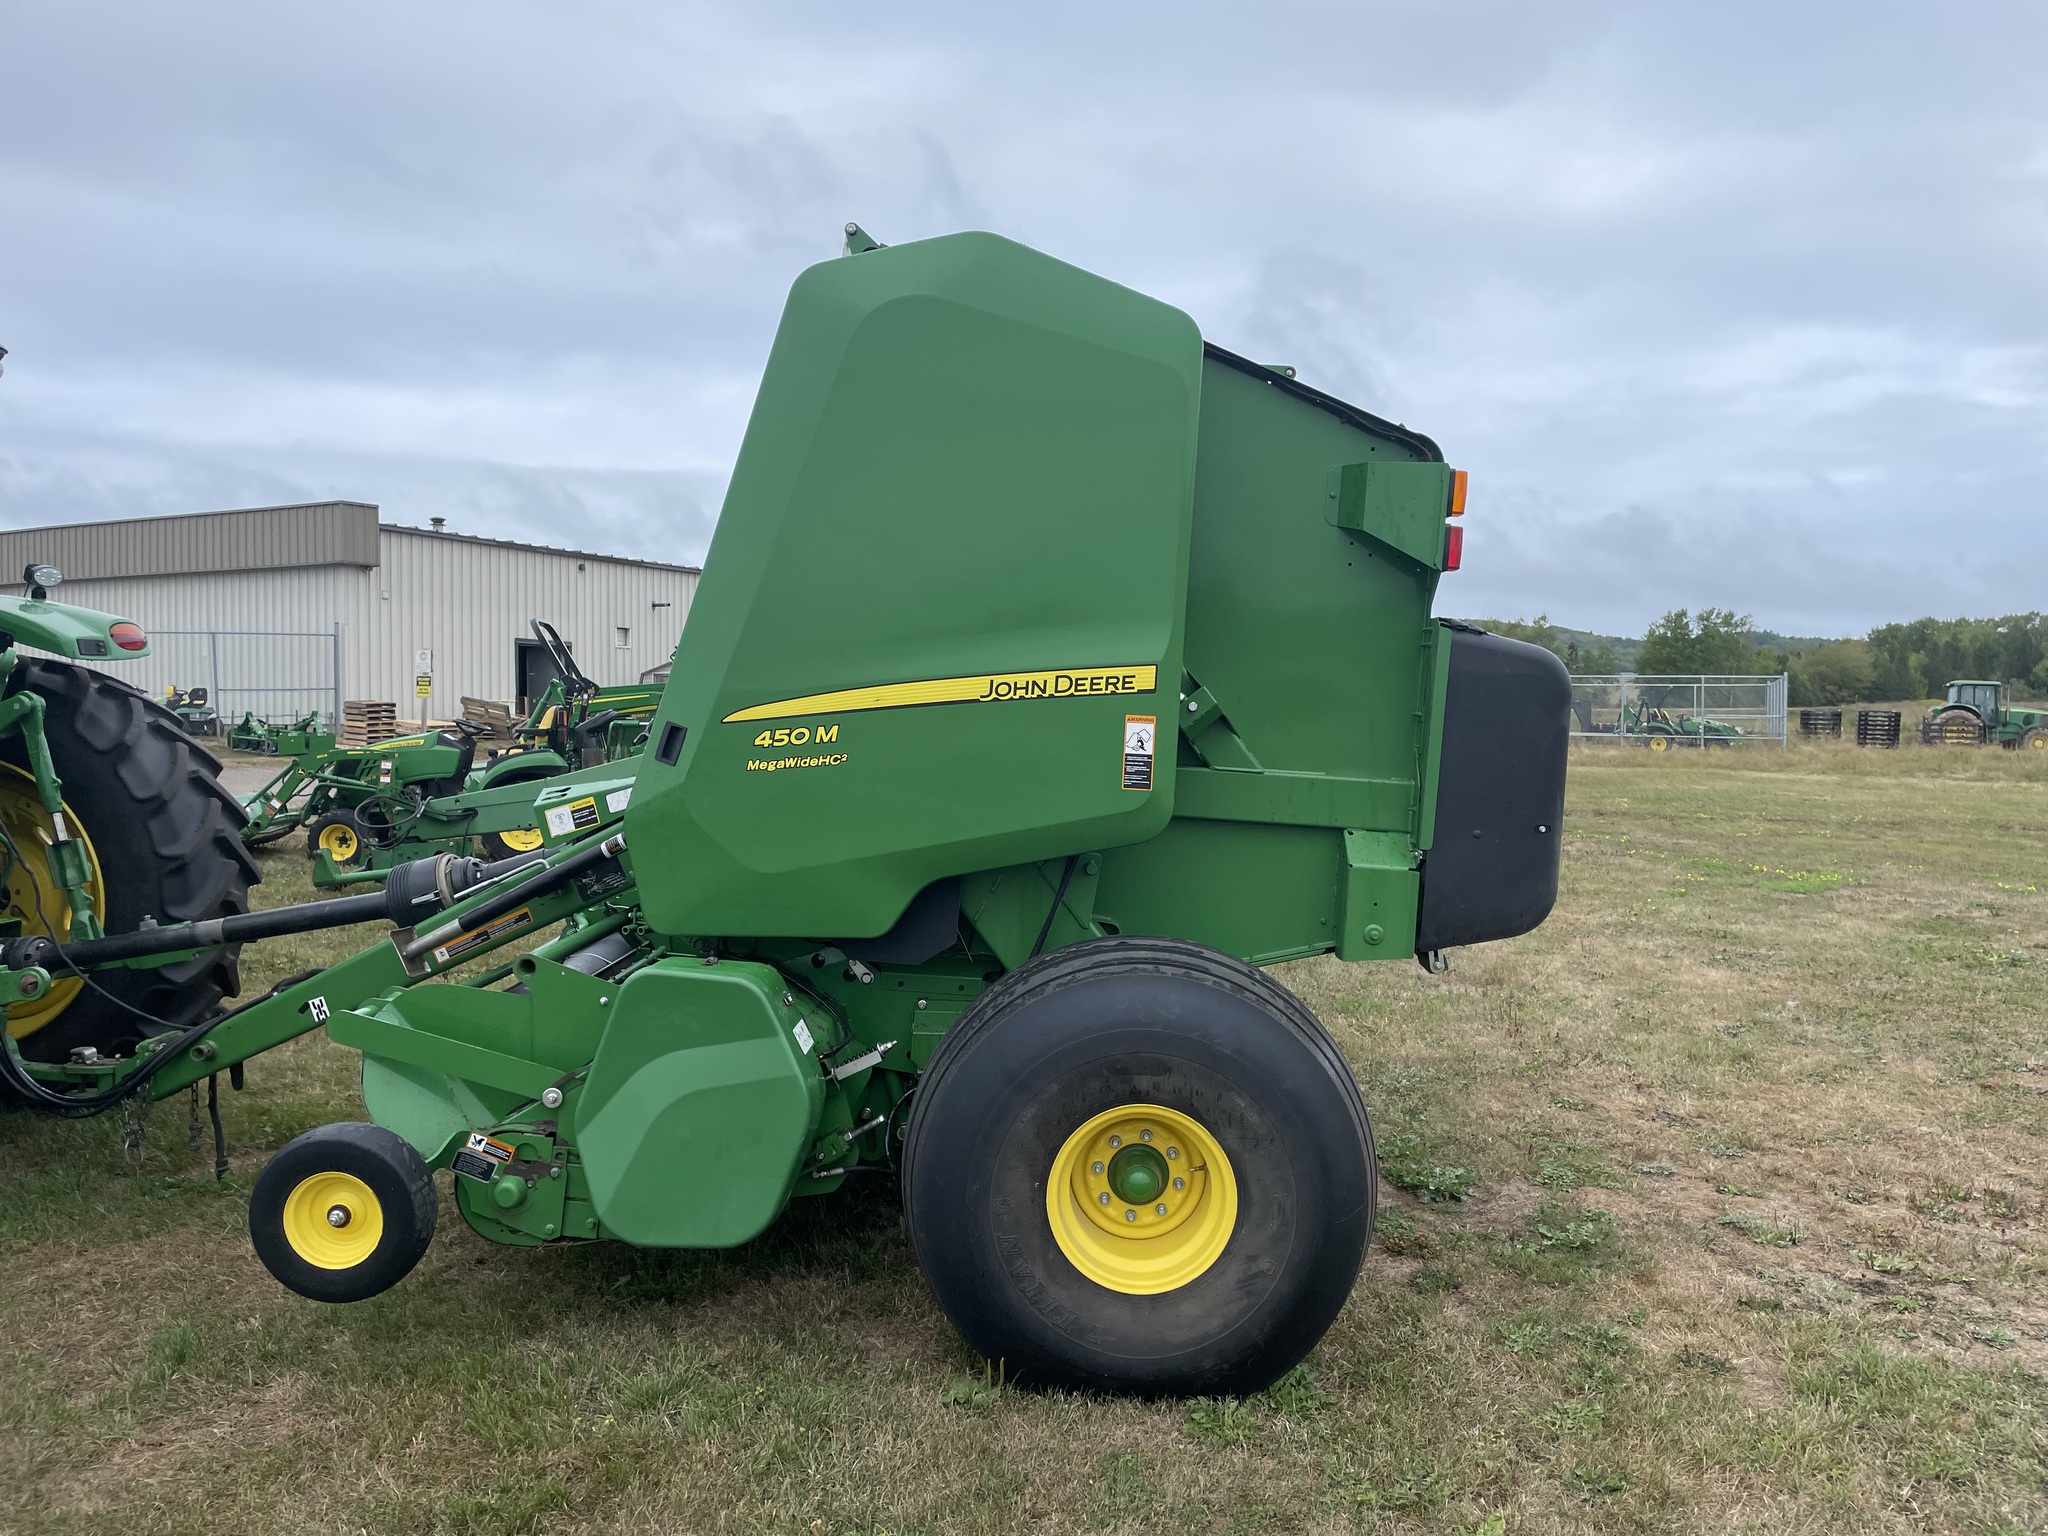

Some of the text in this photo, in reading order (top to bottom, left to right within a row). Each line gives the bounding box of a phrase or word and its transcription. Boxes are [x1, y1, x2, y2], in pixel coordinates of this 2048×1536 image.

[979, 674, 1137, 699] JOHN DEERE
[753, 724, 840, 748] 450 M
[998, 1233, 1081, 1335] TITAN
